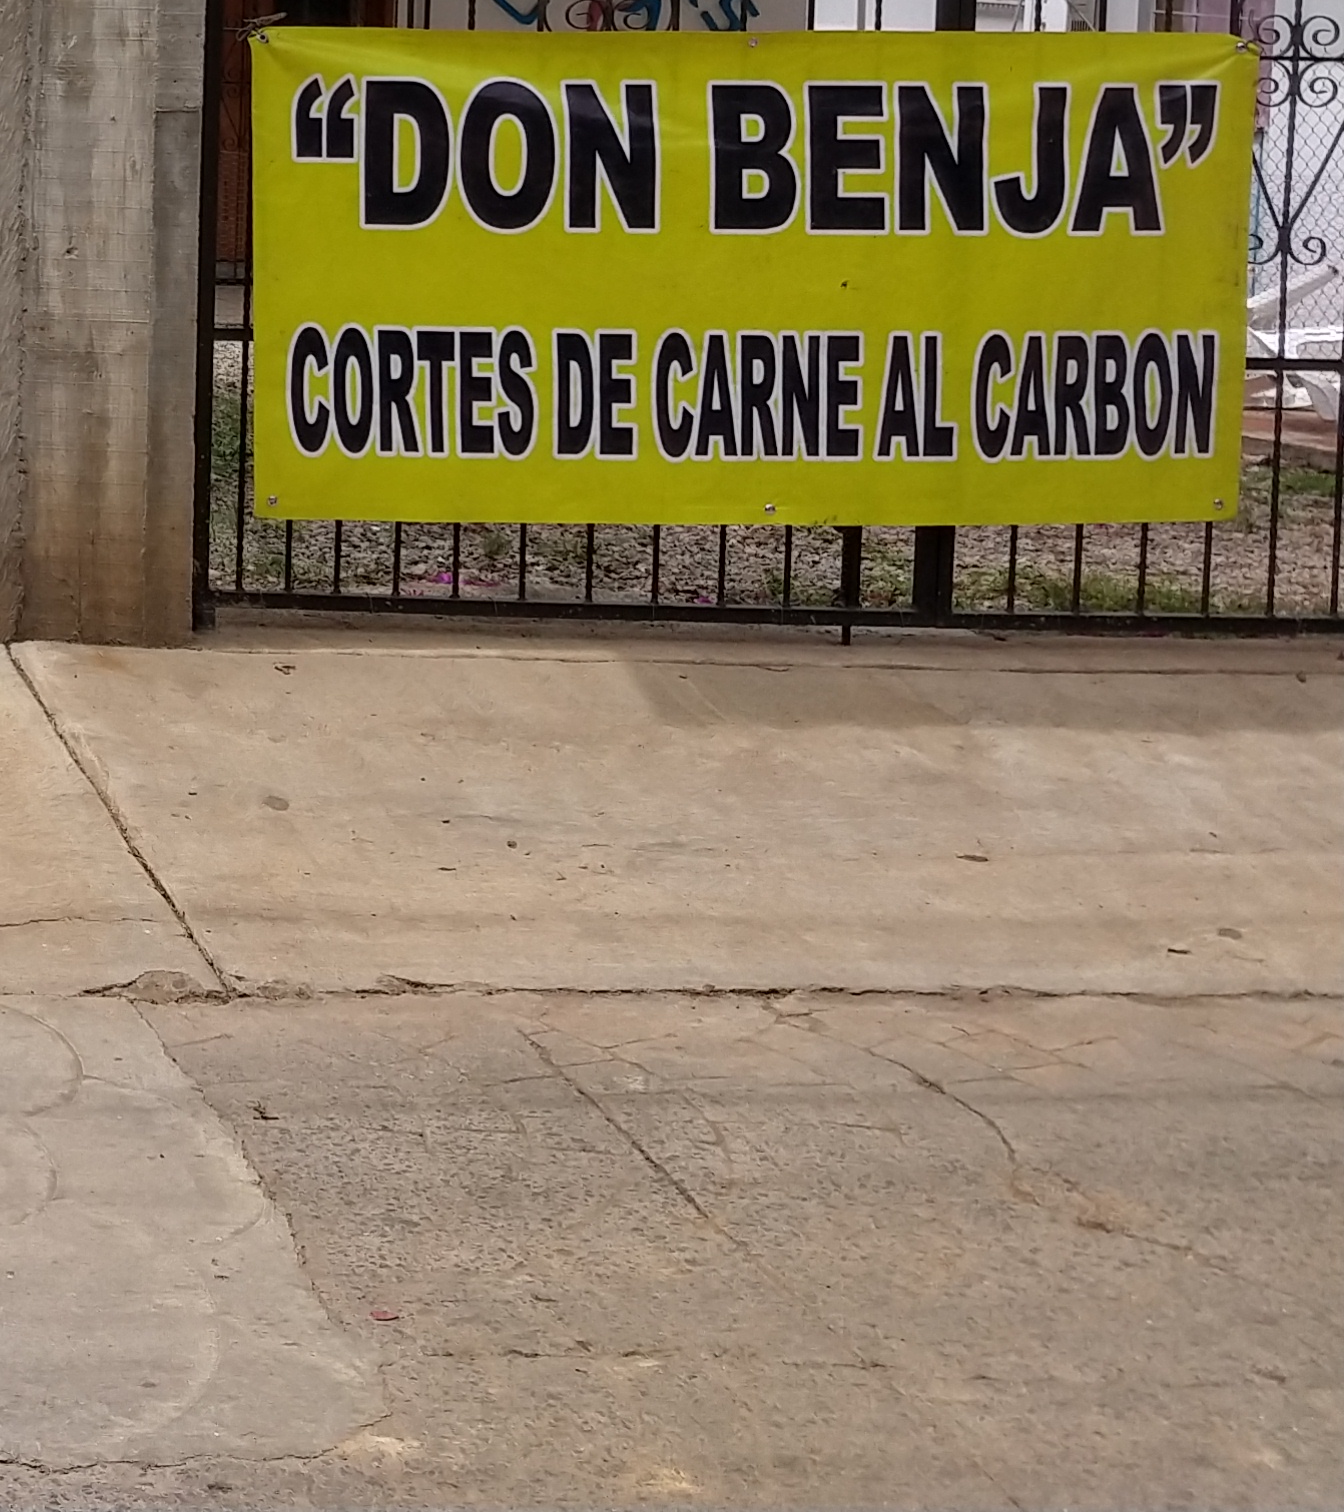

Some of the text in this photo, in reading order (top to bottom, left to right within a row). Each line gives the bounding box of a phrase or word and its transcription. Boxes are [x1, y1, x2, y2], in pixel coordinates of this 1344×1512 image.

[287, 320, 1219, 463] CORTES DE CARNE AL CARBON
